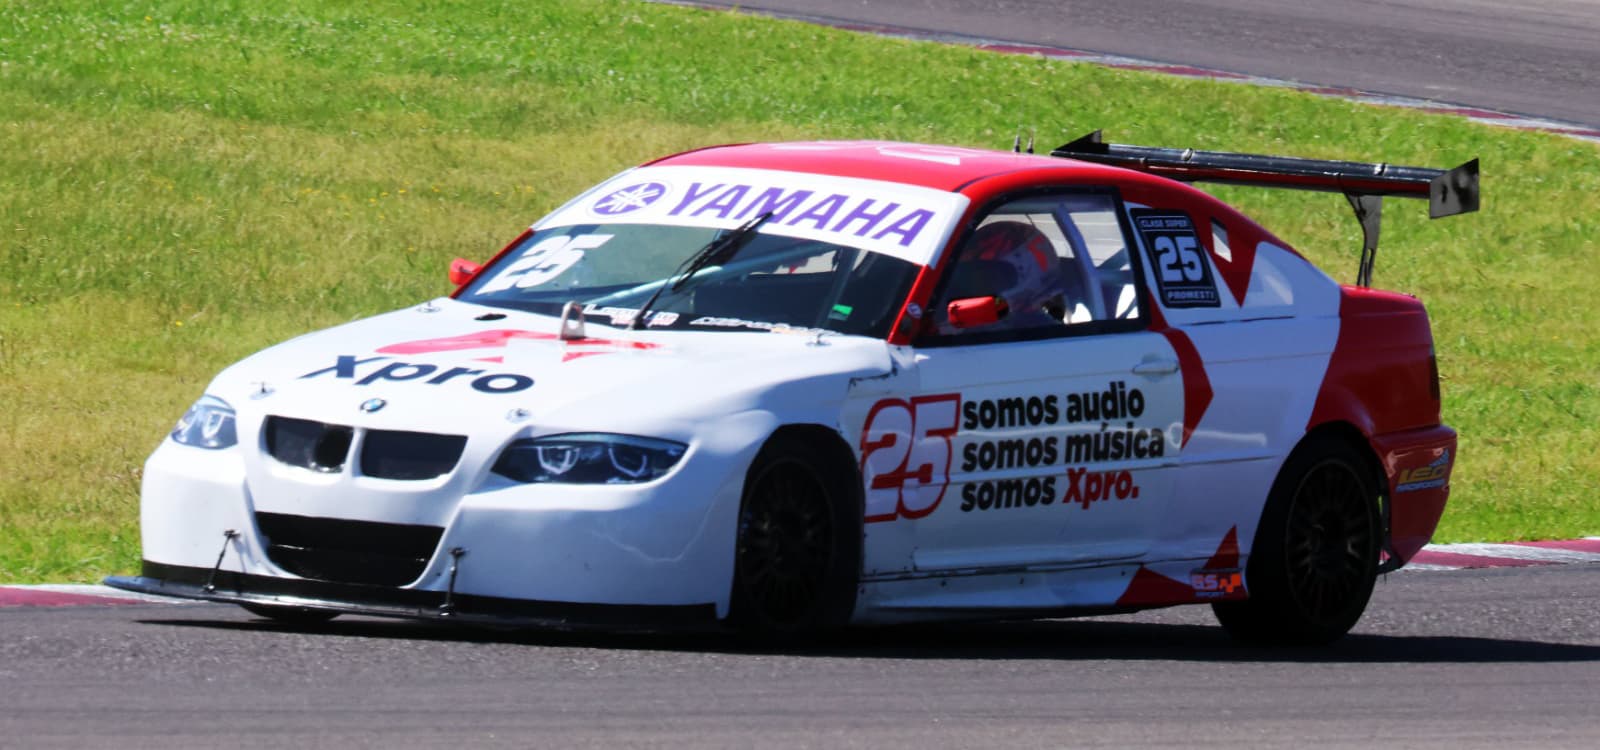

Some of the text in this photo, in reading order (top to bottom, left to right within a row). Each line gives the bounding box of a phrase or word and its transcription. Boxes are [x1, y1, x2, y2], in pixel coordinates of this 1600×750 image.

[668, 182, 936, 247] YAMAHA
[474, 234, 615, 295] 25
[1155, 236, 1204, 281] 25
[297, 355, 535, 393] Xpro
[963, 381, 1145, 430] somos audio
[860, 392, 962, 523] 25
[961, 422, 1165, 472] somos música
[960, 467, 1139, 512] somos Xpro.
